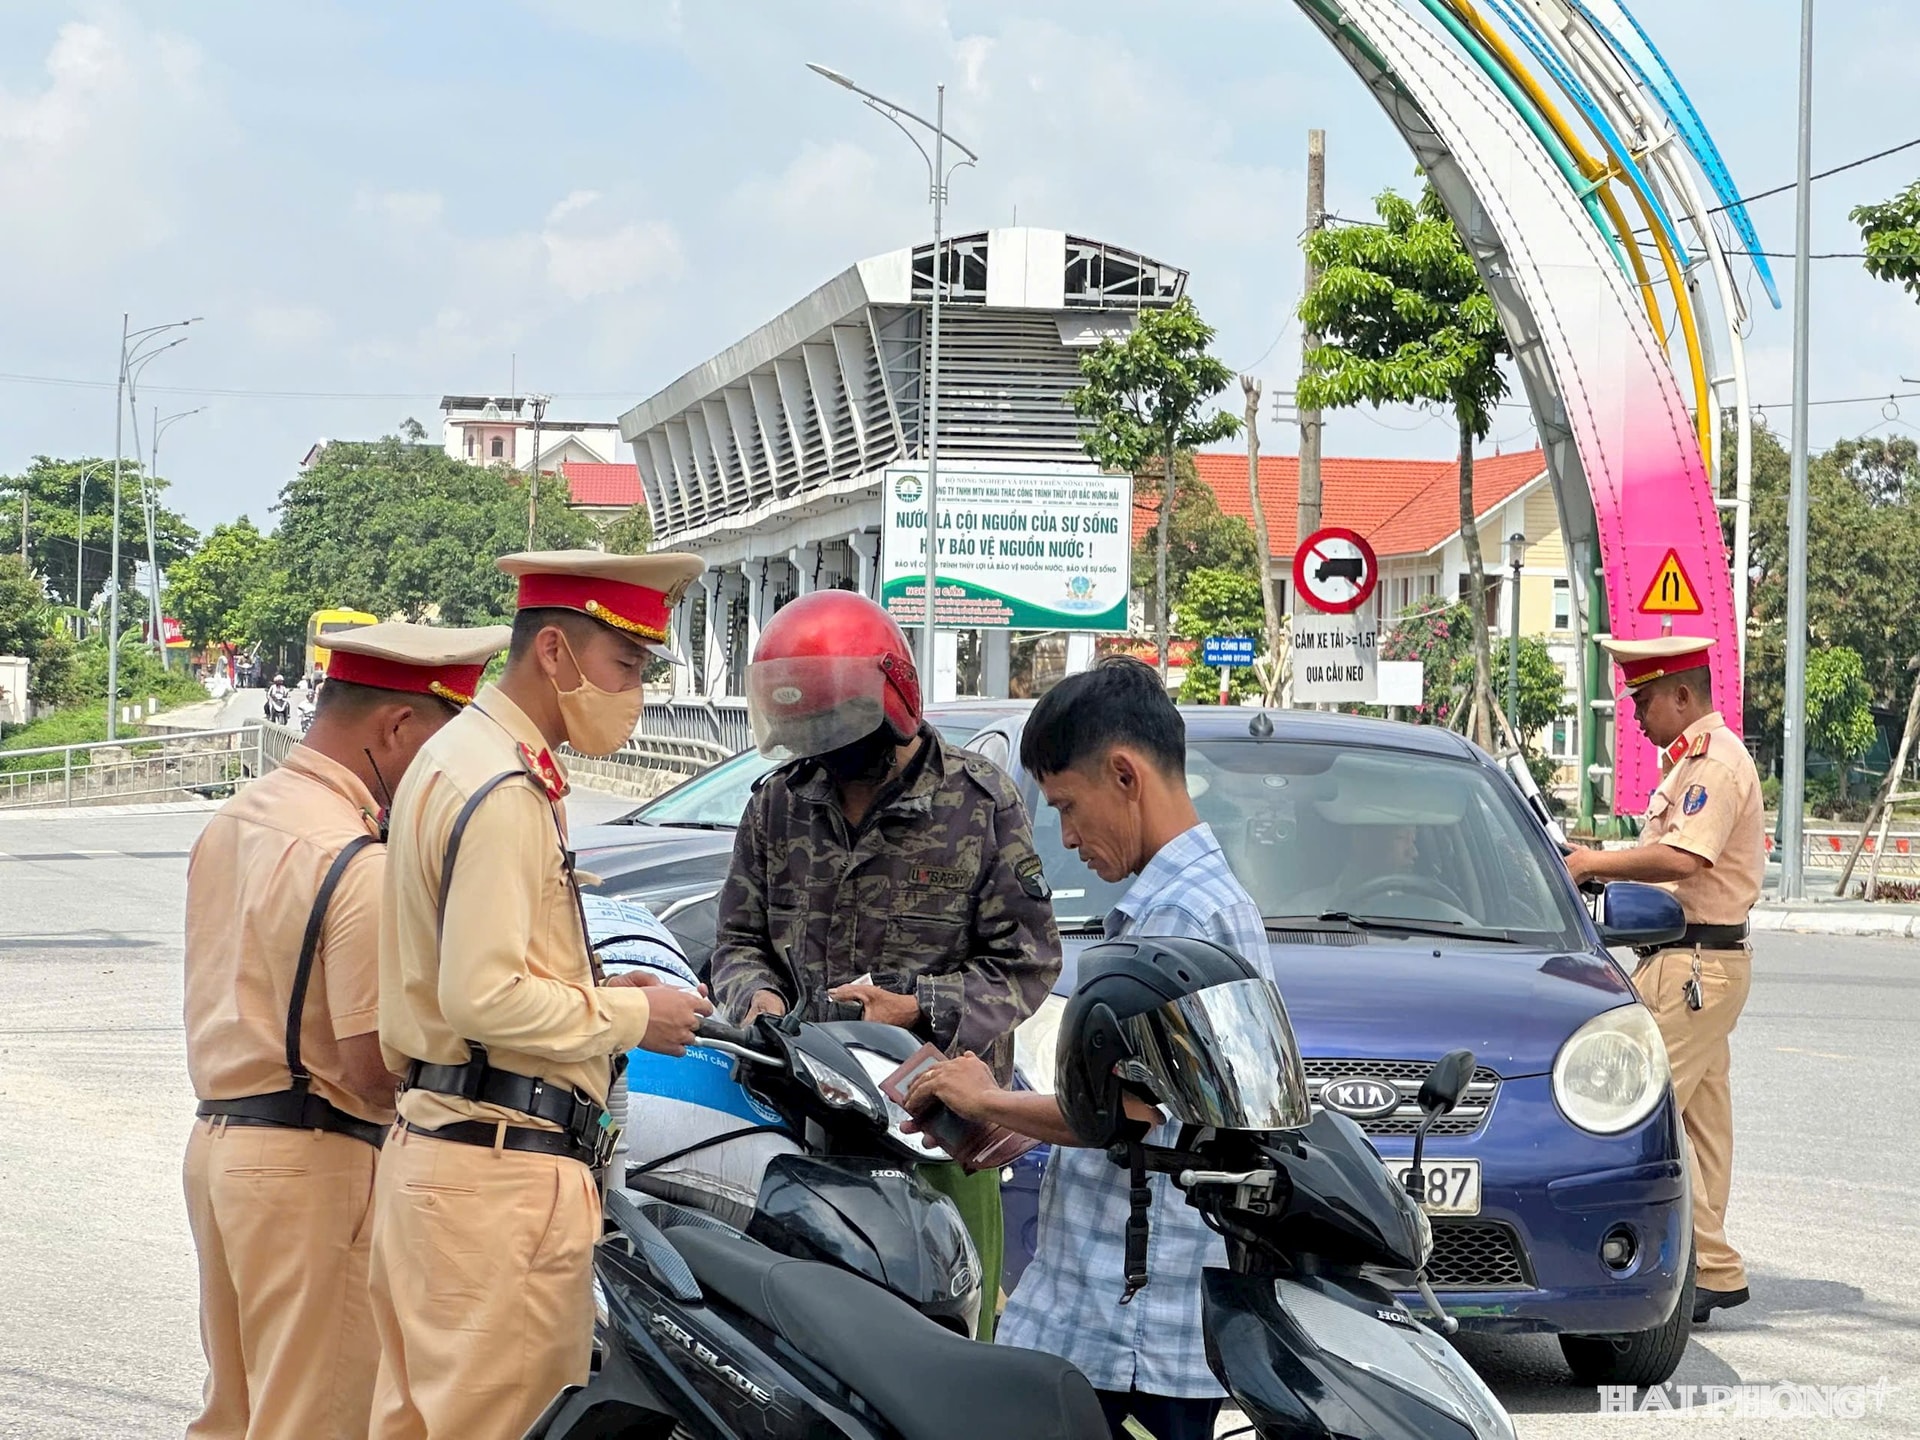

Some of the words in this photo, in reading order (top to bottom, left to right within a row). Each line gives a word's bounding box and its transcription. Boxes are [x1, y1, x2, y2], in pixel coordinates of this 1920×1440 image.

[957, 476, 976, 484] NÔNG
[948, 487, 955, 495] TY
[956, 487, 971, 496] TNHH
[972, 487, 984, 496] MTV
[986, 488, 1000, 496] KHAI
[1001, 487, 1014, 497] THÁC
[1017, 486, 1033, 497] CÔNG
[1034, 487, 1051, 497] TRÌNH
[1069, 488, 1078, 500] LỢI
[1079, 488, 1090, 499] BẮC
[1092, 489, 1107, 499] HƯNG
[1109, 488, 1119, 500] HẢI
[936, 508, 952, 529] LÀ
[956, 509, 977, 533] CỘI
[982, 508, 1027, 532] NGUỒN
[1031, 509, 1057, 533] CỦA
[1061, 514, 1080, 537] SỰ
[1083, 510, 1118, 534] SỐNG
[920, 537, 945, 554] HY
[949, 533, 975, 555] BẢO
[979, 536, 995, 559] VỆ
[999, 534, 1045, 558] NGUỒN
[1049, 538, 1084, 558] NƯỚC
[1088, 541, 1093, 559] !
[895, 560, 908, 568] BẢO
[910, 560, 917, 569] VỆ
[940, 560, 958, 569] TRÌNH
[976, 561, 986, 570] LỢI
[987, 561, 995, 570] LÀ
[996, 561, 1009, 570] BẢO
[1011, 562, 1018, 571] VỆ
[1020, 561, 1043, 571] NGUỒN
[1066, 563, 1079, 572] BẢO
[1081, 564, 1088, 573] VỆ
[1090, 565, 1098, 574] SỰ
[1099, 564, 1117, 573] SỐNG
[1206, 638, 1220, 650] CẦU
[1221, 639, 1238, 651] CỐNG
[1239, 641, 1252, 651] NEO
[1295, 627, 1315, 649] CẤM
[1317, 632, 1328, 649] XE
[1330, 626, 1343, 649] TẢI
[1306, 665, 1324, 684] QUA
[1326, 660, 1343, 682] CẦU
[1346, 665, 1364, 682] NEO
[1337, 1086, 1386, 1105] KIA
[652, 1312, 695, 1349] AIR
[695, 1342, 771, 1404] BLADE
